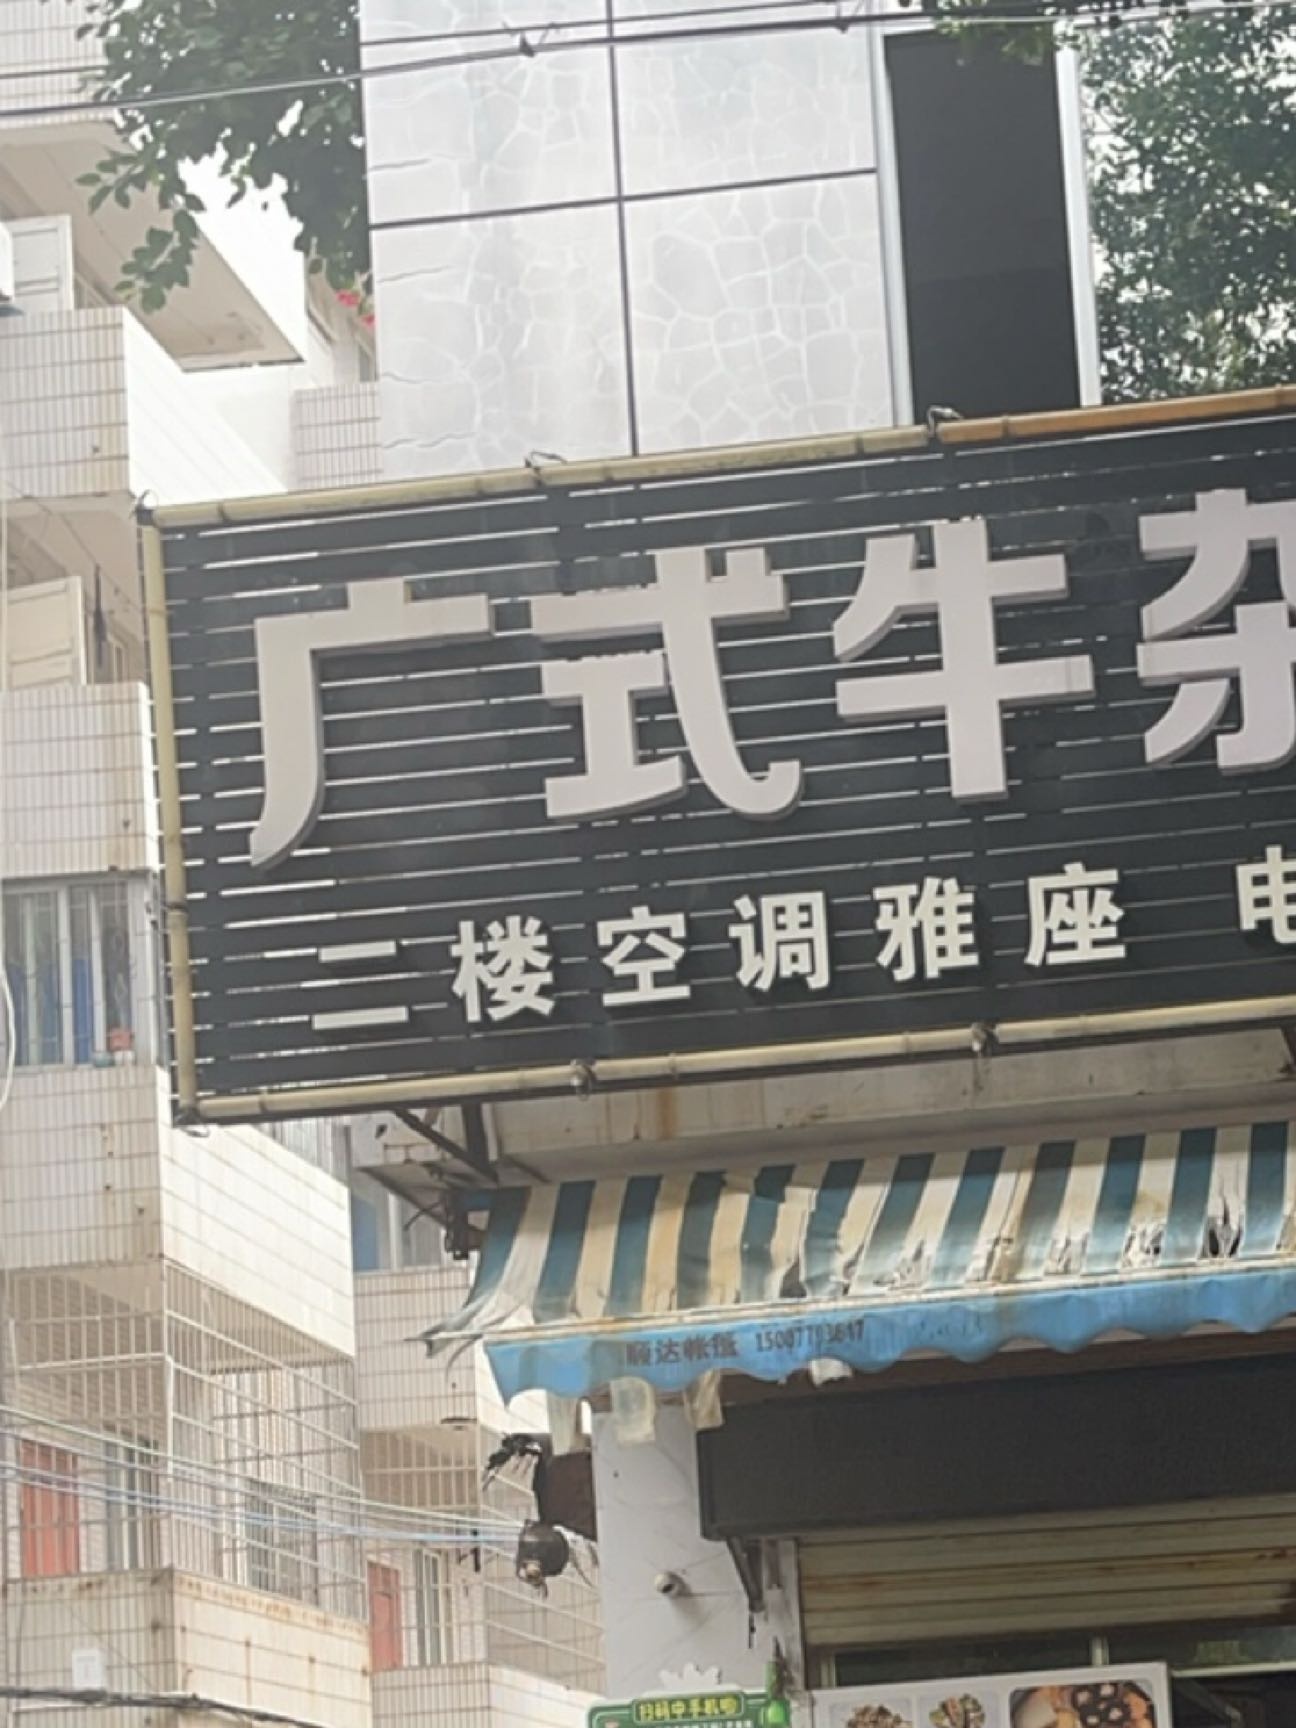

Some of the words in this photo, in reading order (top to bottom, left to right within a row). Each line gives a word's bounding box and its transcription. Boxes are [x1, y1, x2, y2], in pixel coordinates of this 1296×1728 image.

[311, 862, 1126, 1032] 二楼空调雅座
